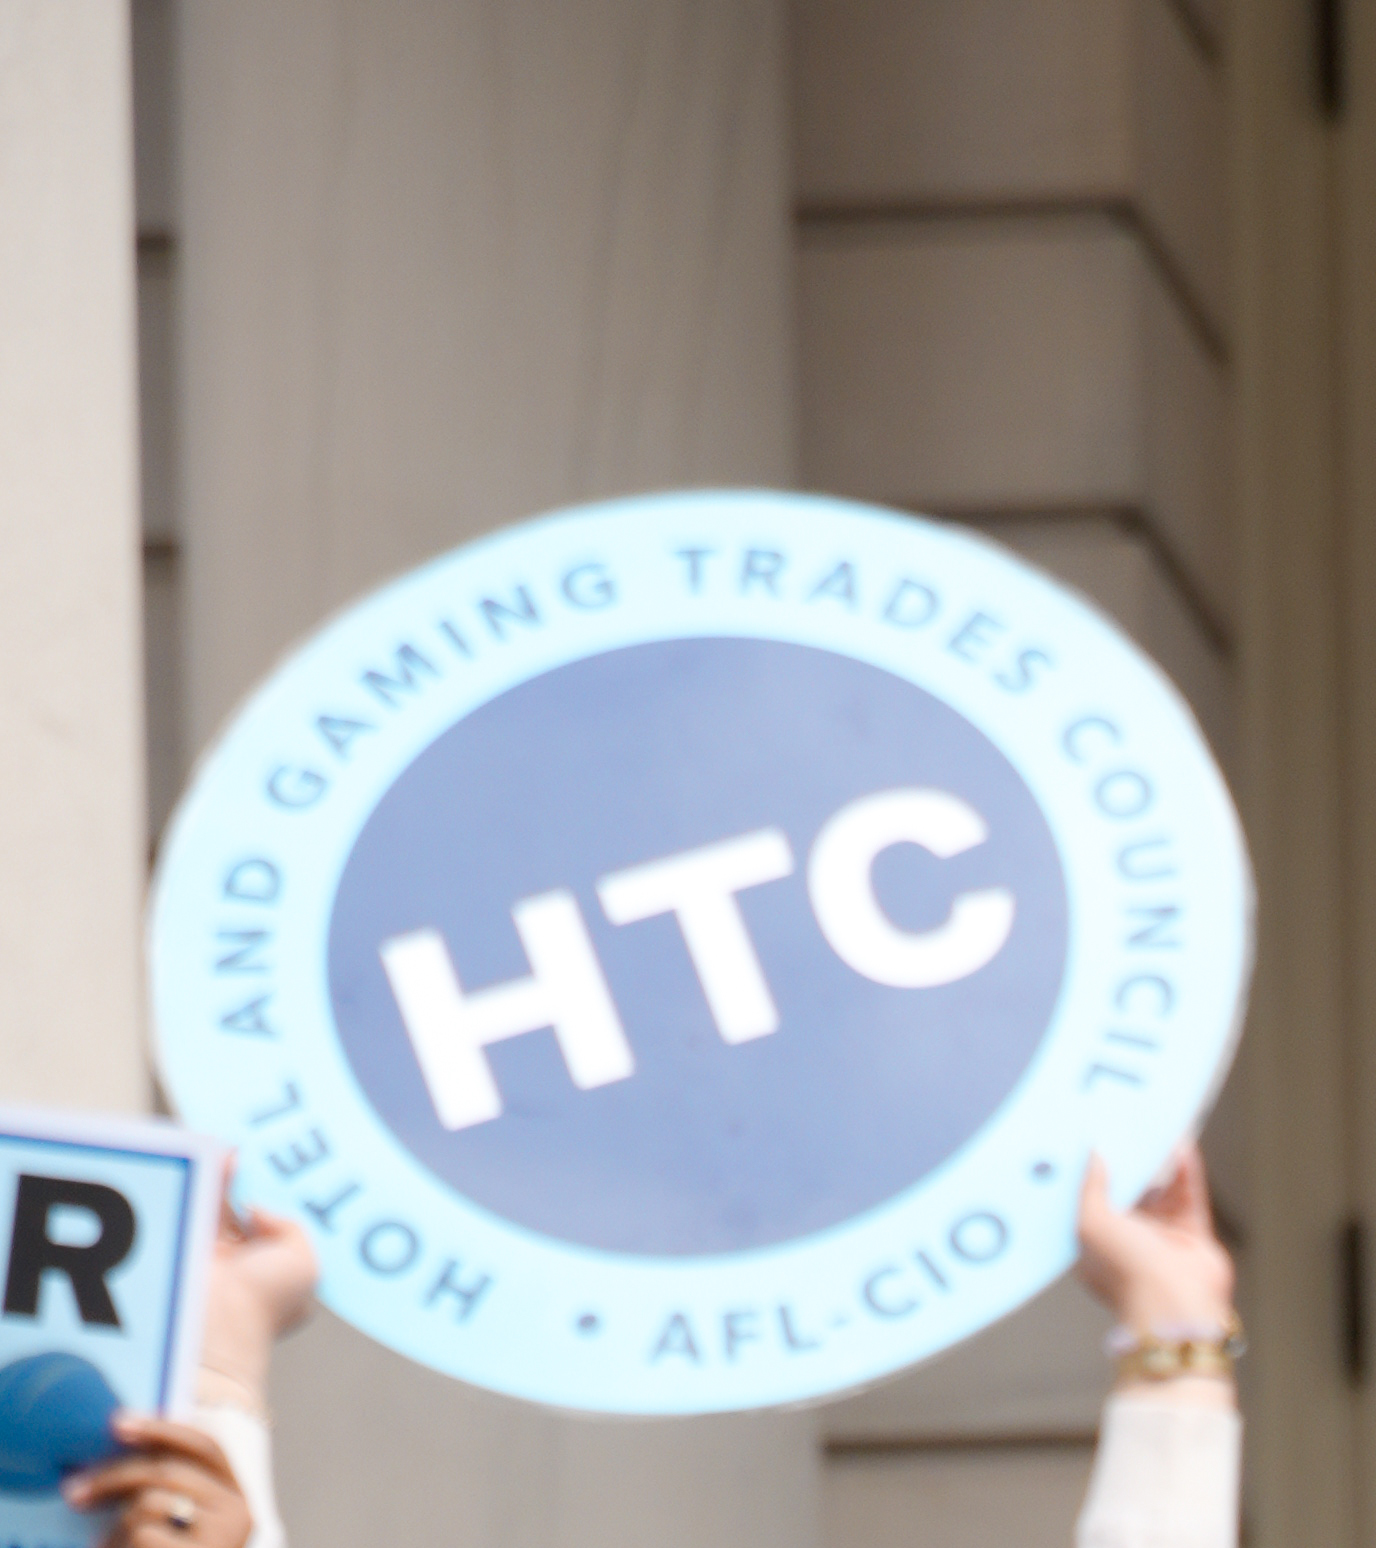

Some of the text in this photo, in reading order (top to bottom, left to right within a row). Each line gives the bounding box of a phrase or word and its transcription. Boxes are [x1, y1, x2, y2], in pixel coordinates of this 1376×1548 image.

[216, 547, 1186, 1324] HOTEL AND GAMING TRADES COUNCIL
[379, 786, 1016, 1129] HTC
[648, 1207, 1014, 1365] AFL-CIO
